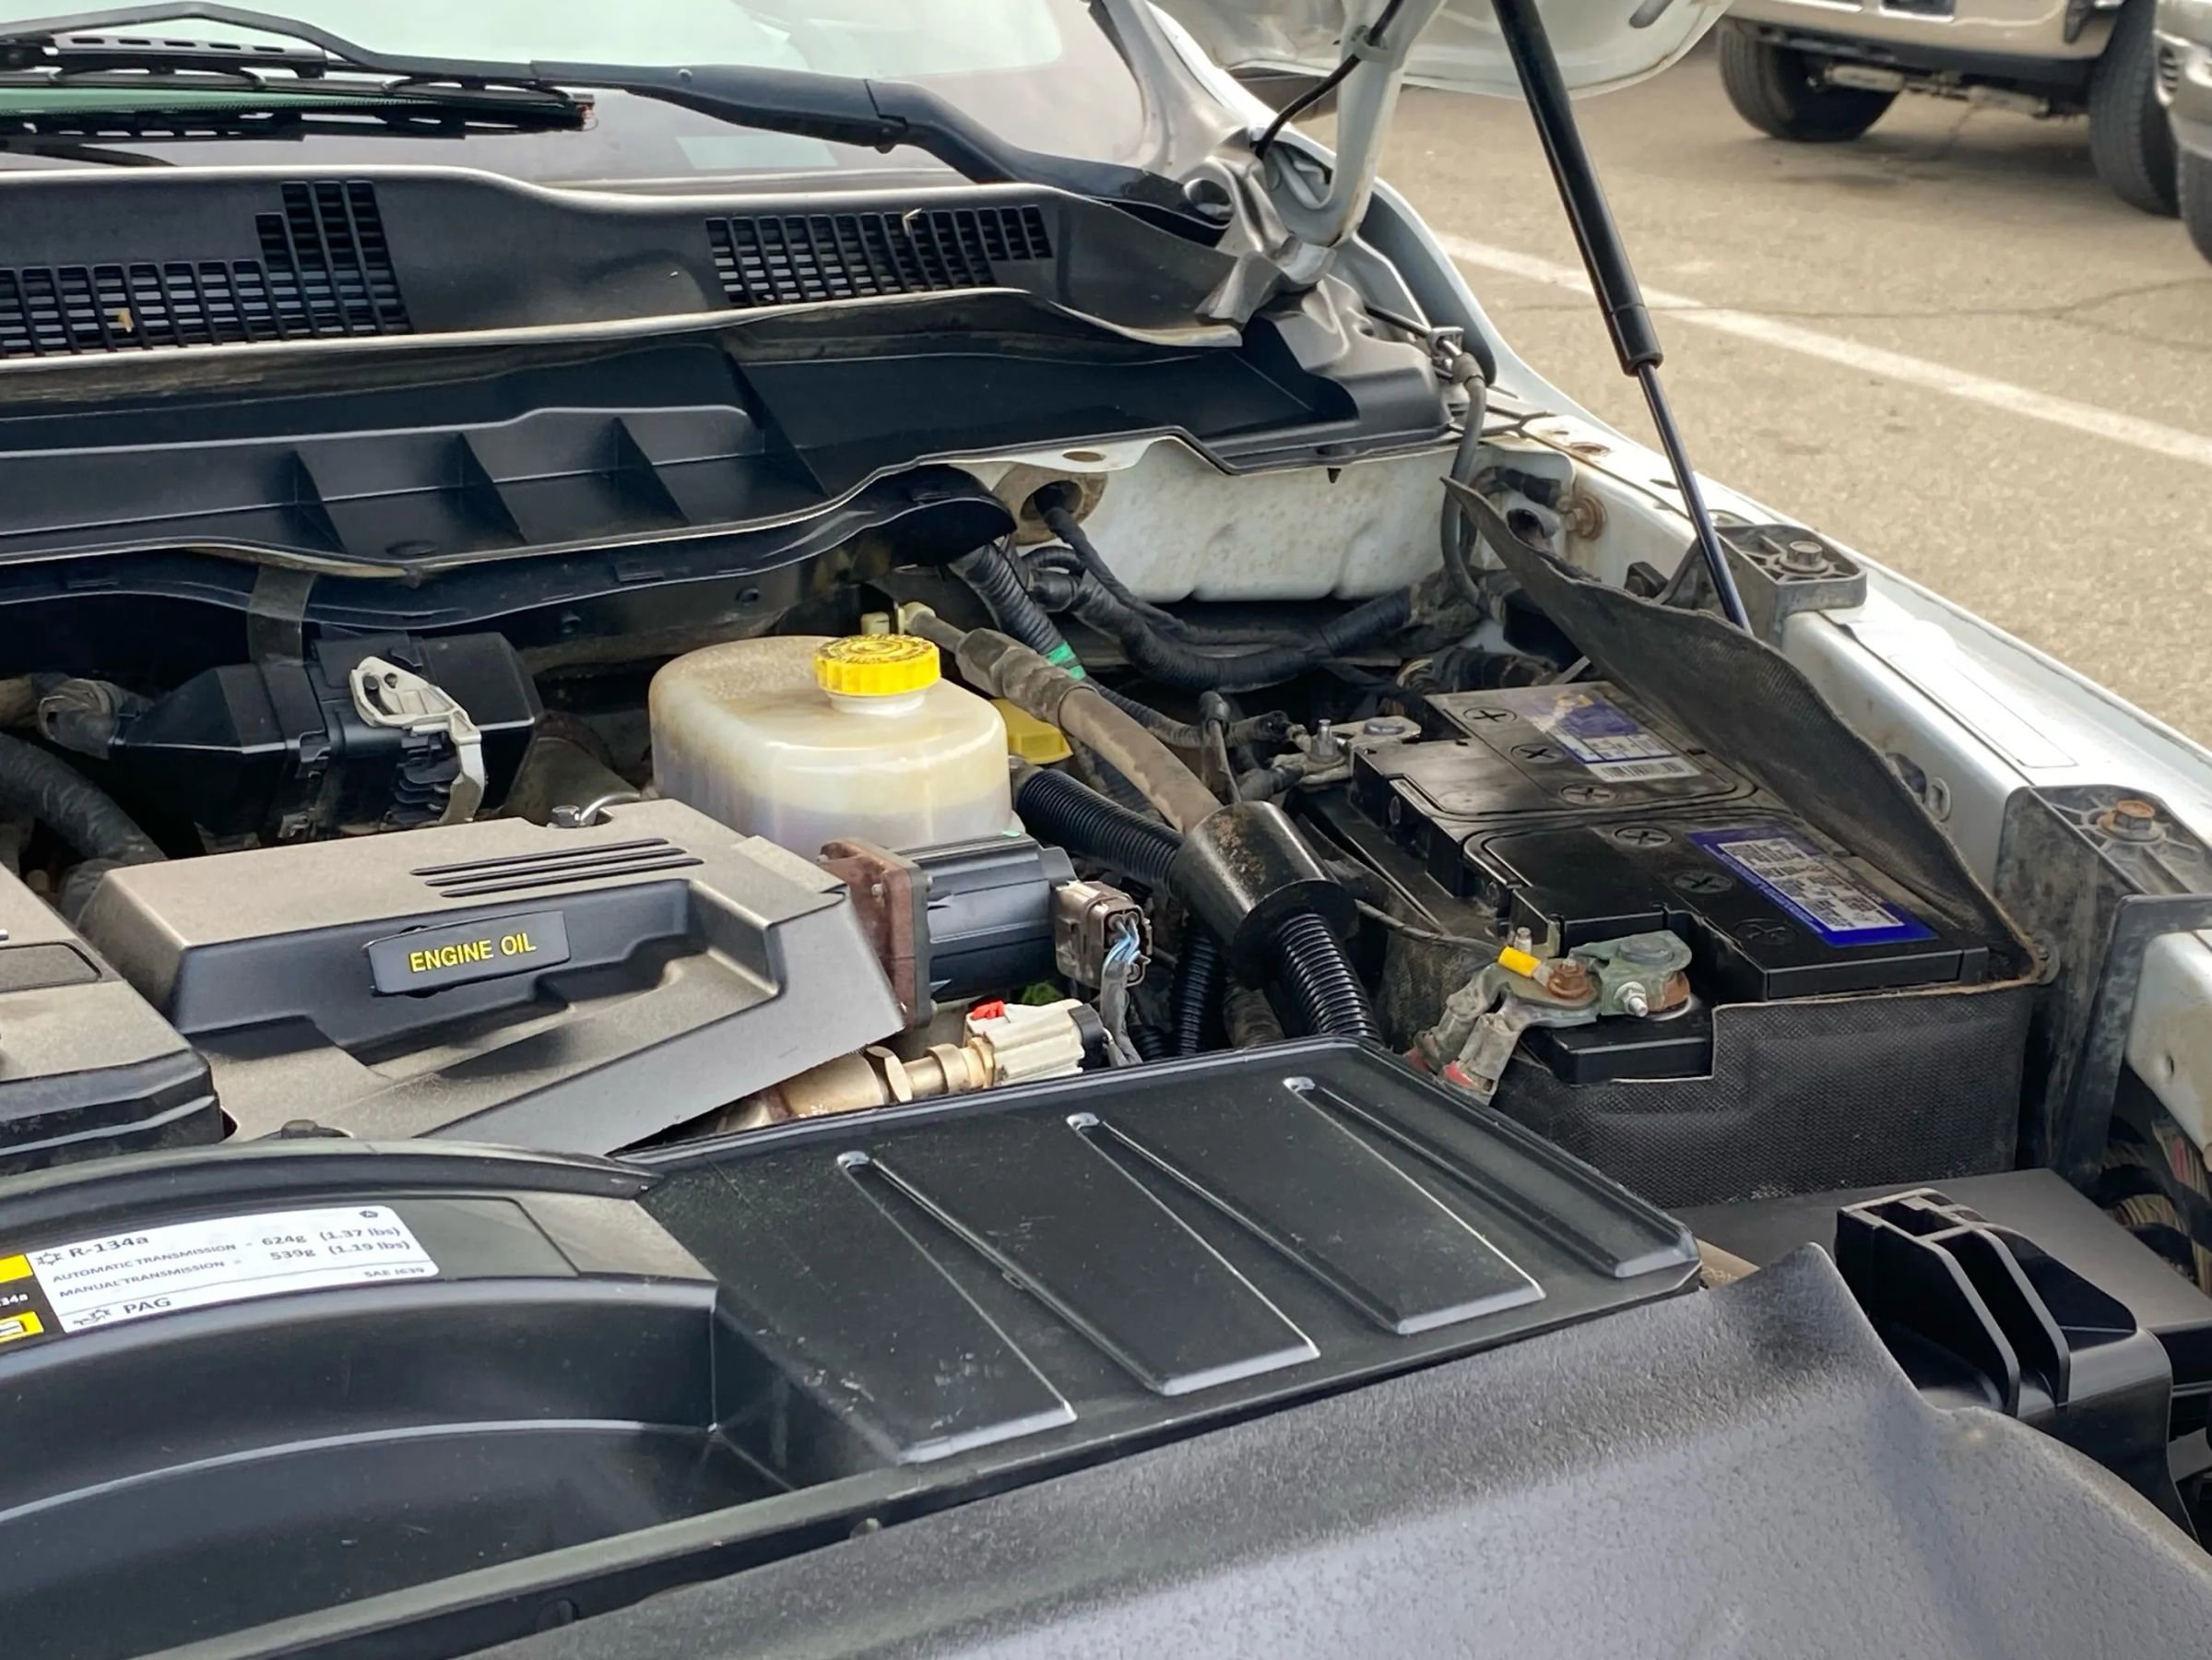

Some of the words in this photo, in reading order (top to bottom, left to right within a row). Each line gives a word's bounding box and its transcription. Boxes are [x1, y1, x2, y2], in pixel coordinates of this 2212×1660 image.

[408, 940, 494, 972] ENGINE
[500, 932, 538, 956] OIL
[53, 1260, 135, 1284] AUTOMATIC
[136, 1243, 237, 1266] TRANSMISSION
[262, 1234, 308, 1247] 624g
[319, 1228, 363, 1242] (1.37
[368, 1226, 401, 1239] lbs)
[68, 1236, 149, 1258] R-134a
[59, 1280, 119, 1298] MANUAL
[123, 1261, 226, 1285] TRANSMISSION
[269, 1249, 316, 1261] 539g
[377, 1239, 411, 1251] lbs)
[123, 1297, 172, 1315] PAG
